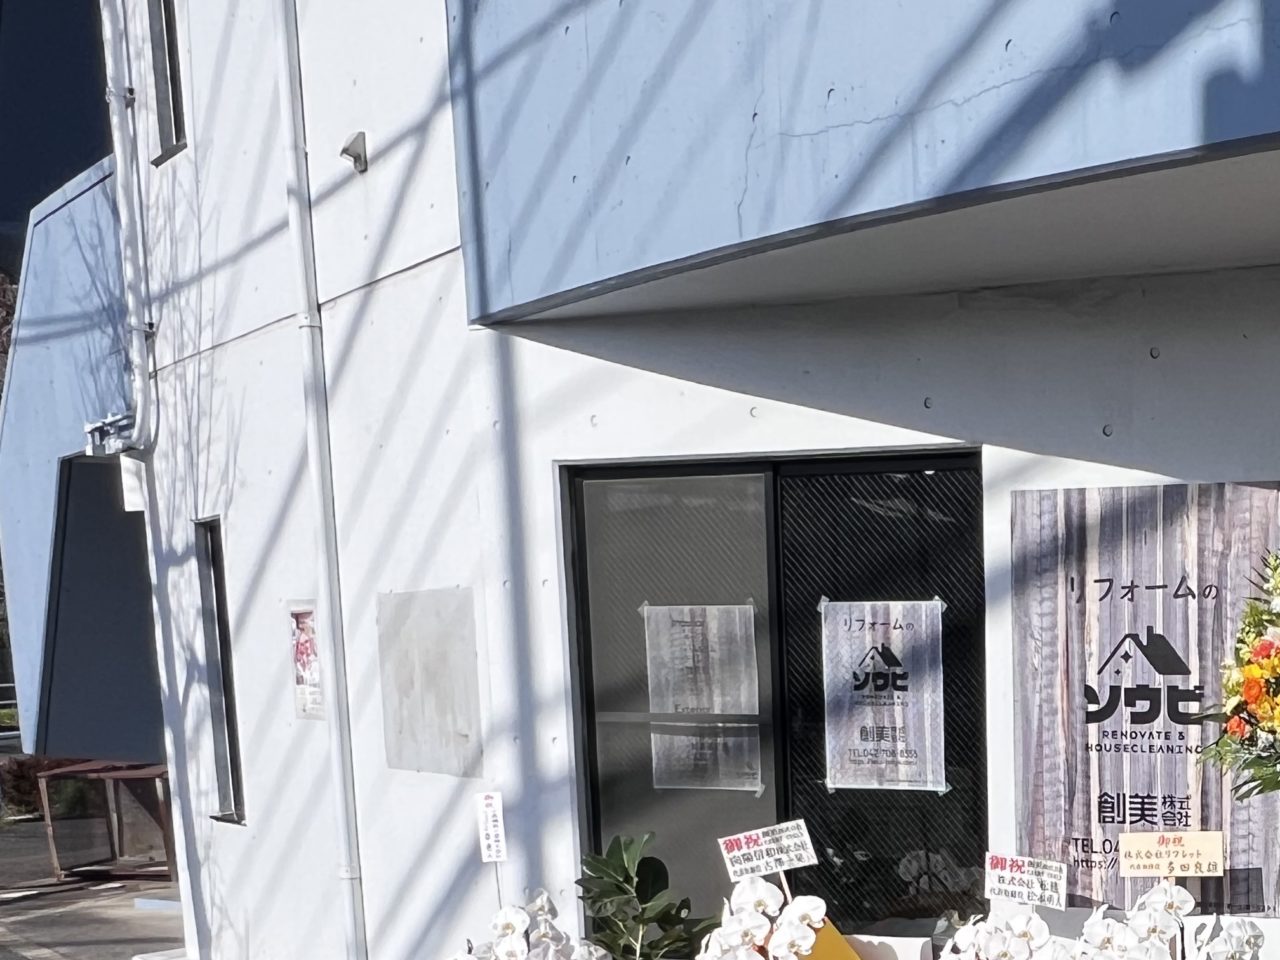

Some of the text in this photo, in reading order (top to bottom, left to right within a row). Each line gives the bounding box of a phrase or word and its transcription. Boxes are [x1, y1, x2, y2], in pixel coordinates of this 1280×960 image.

[1070, 575, 1219, 603] リフォームの
[843, 617, 915, 632] リフォームの
[1102, 730, 1172, 740] RENOVATE
[989, 855, 1026, 875] 御祝
